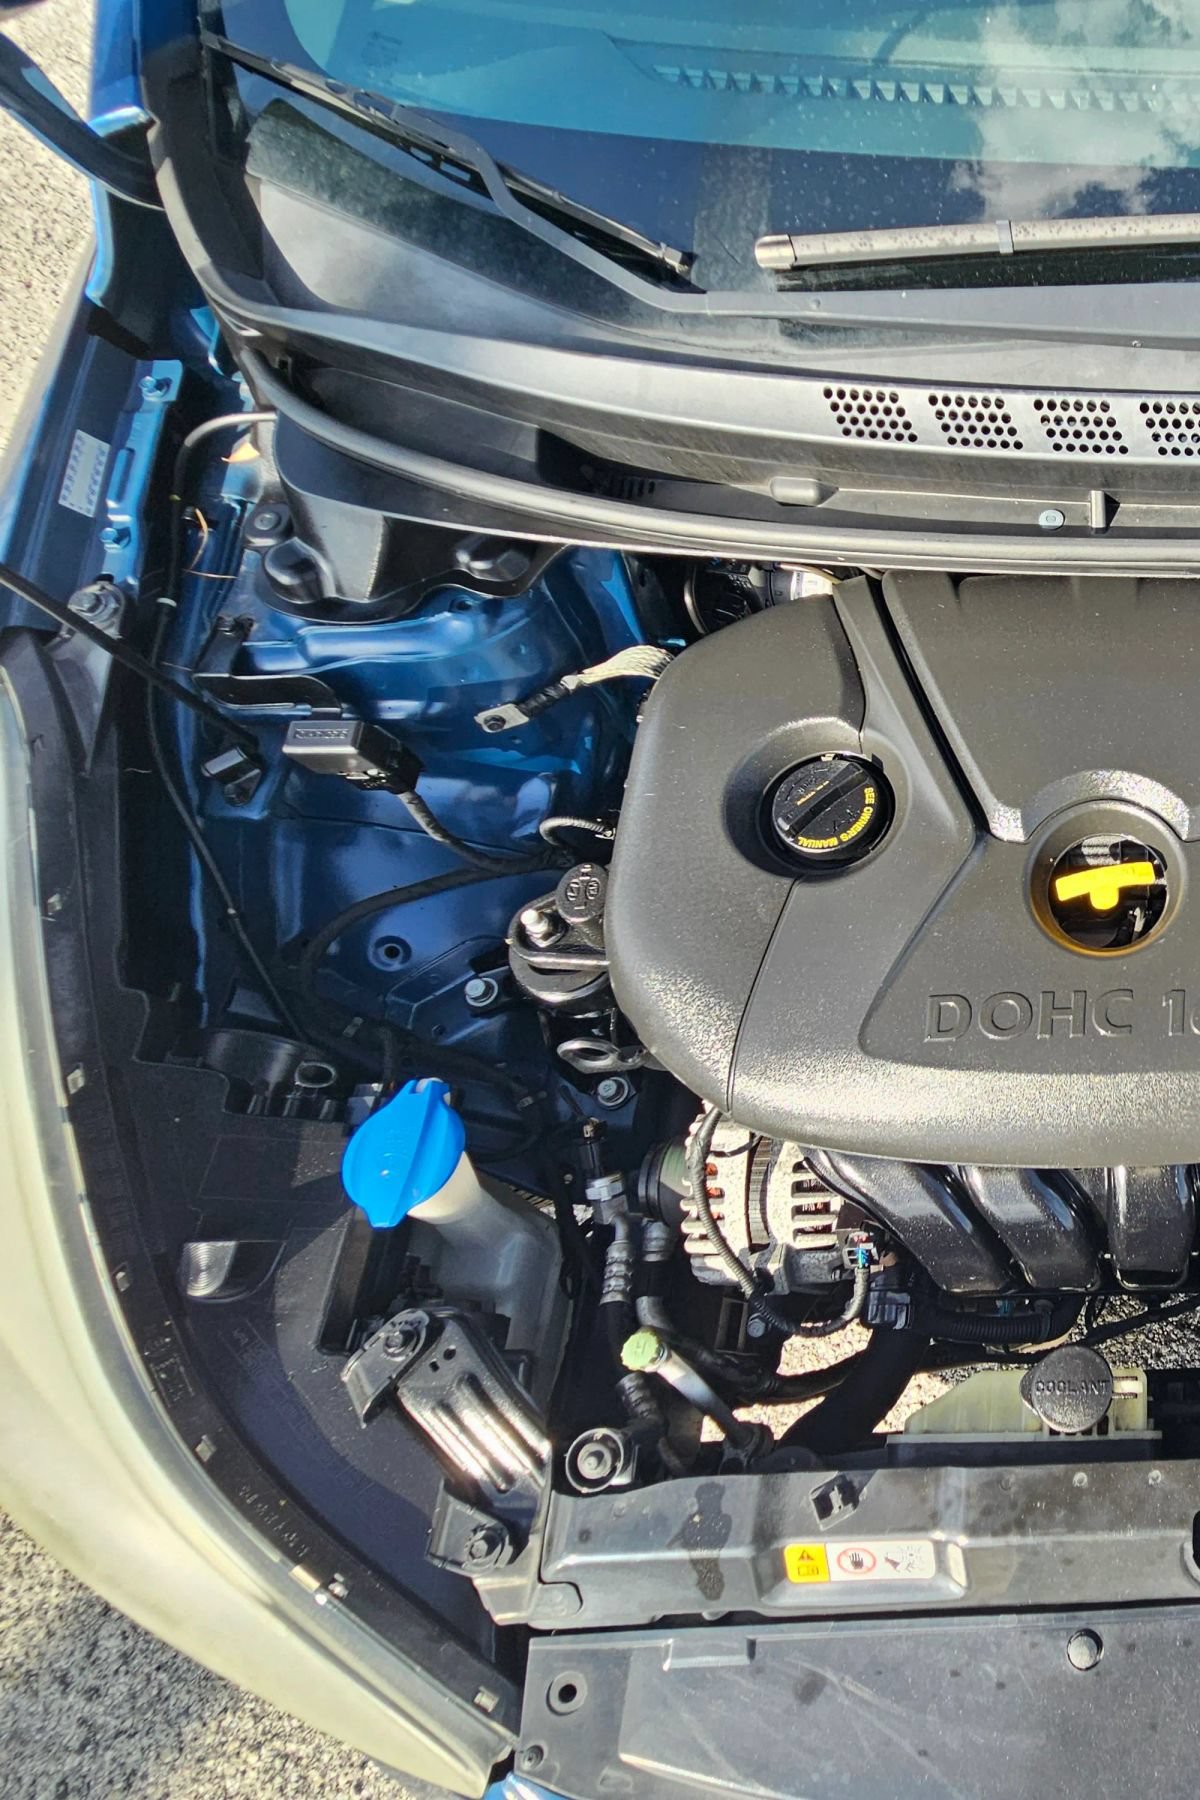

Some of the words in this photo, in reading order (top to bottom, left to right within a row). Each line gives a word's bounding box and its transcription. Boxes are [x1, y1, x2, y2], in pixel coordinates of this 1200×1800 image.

[864, 787, 875, 804] SEE
[840, 806, 874, 842] OWNER'S
[798, 836, 838, 848] MANUAL
[923, 988, 1134, 1043] DOHC
[1035, 1380, 1110, 1396] COOLANT
